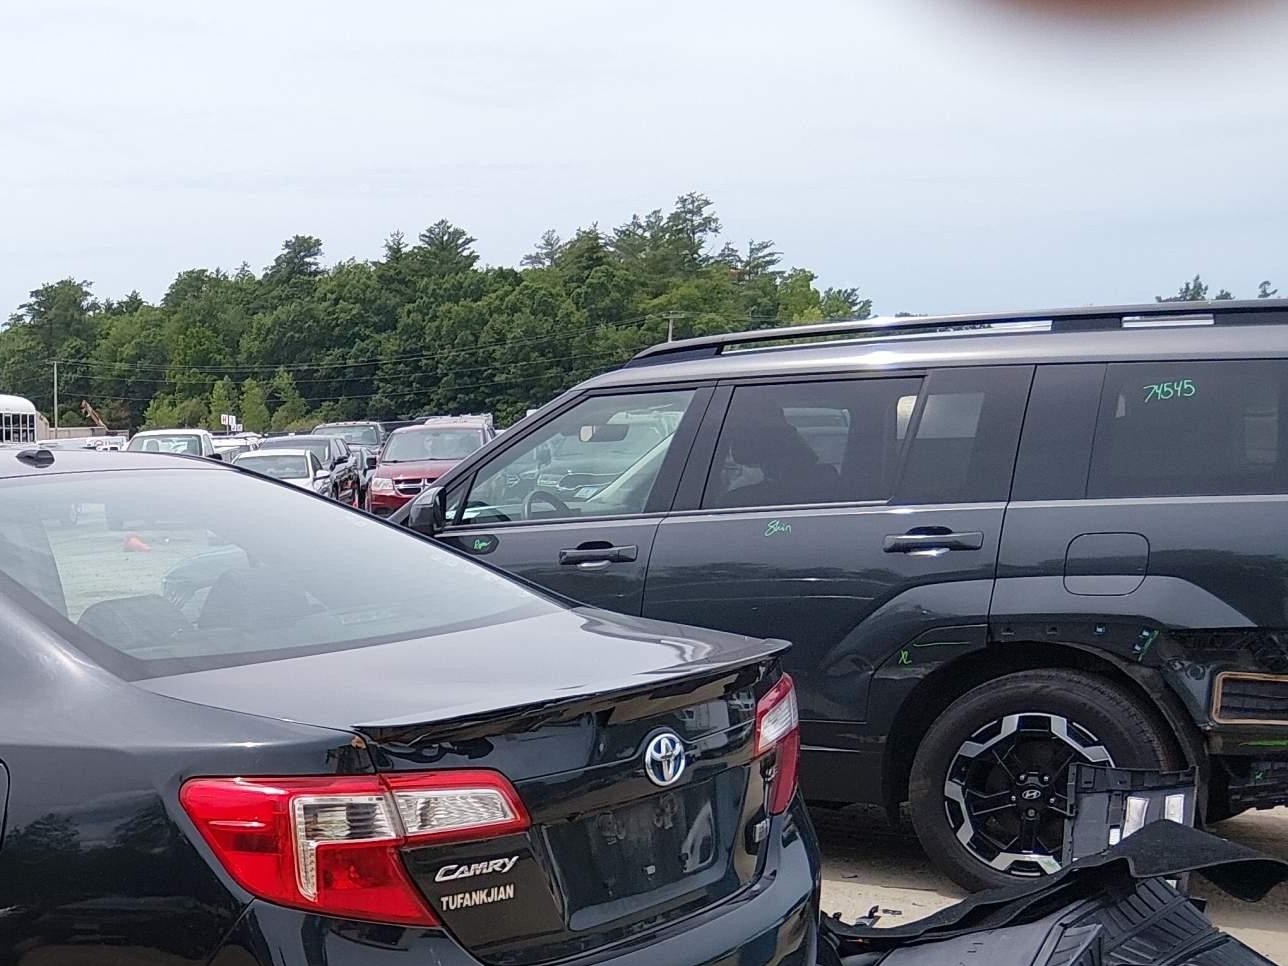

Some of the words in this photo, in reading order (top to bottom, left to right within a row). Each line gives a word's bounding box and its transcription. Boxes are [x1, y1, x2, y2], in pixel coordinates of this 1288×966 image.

[1143, 379, 1196, 403] 74545
[434, 855, 520, 882] CAMRY
[440, 884, 515, 911] TUFANKJIAN
